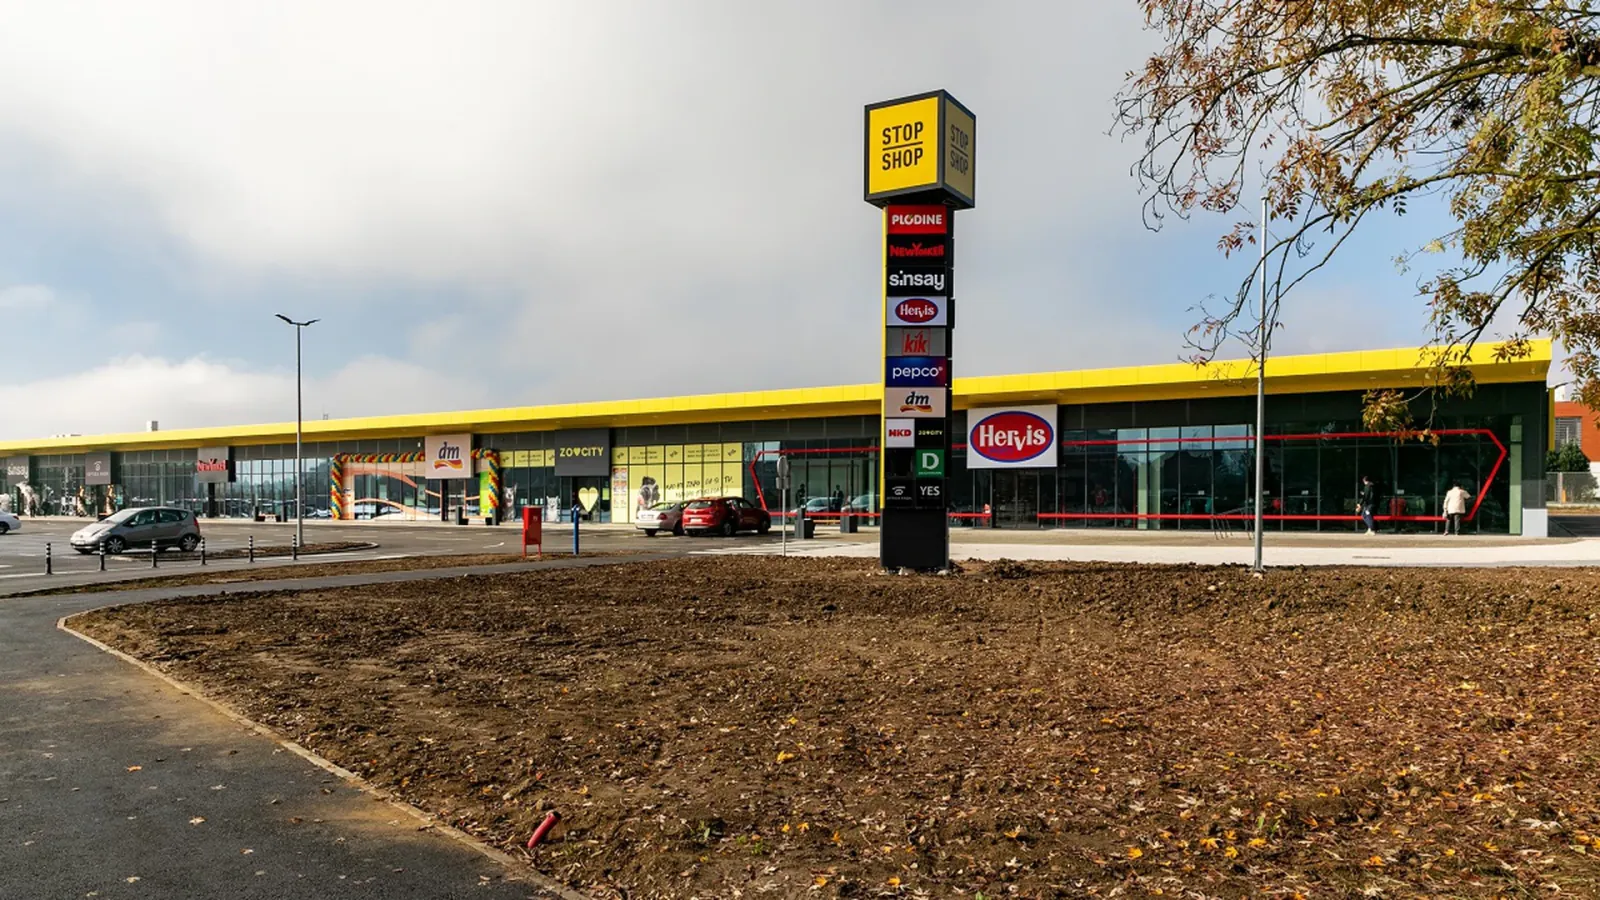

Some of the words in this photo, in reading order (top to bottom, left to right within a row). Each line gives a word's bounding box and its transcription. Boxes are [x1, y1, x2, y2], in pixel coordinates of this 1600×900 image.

[882, 121, 924, 145] STOP
[950, 124, 968, 148] STOP
[882, 147, 924, 171] SHOP
[950, 152, 968, 176] SHOP
[892, 213, 942, 225] PLODINE
[889, 270, 945, 291] sinsay
[900, 304, 935, 318] Hervis
[904, 331, 929, 353] kik
[905, 391, 929, 405] dm
[888, 429, 912, 437] NKD
[979, 424, 1047, 451] Hervis
[438, 441, 460, 459] dm
[922, 452, 940, 470] D
[920, 486, 940, 496] YES
